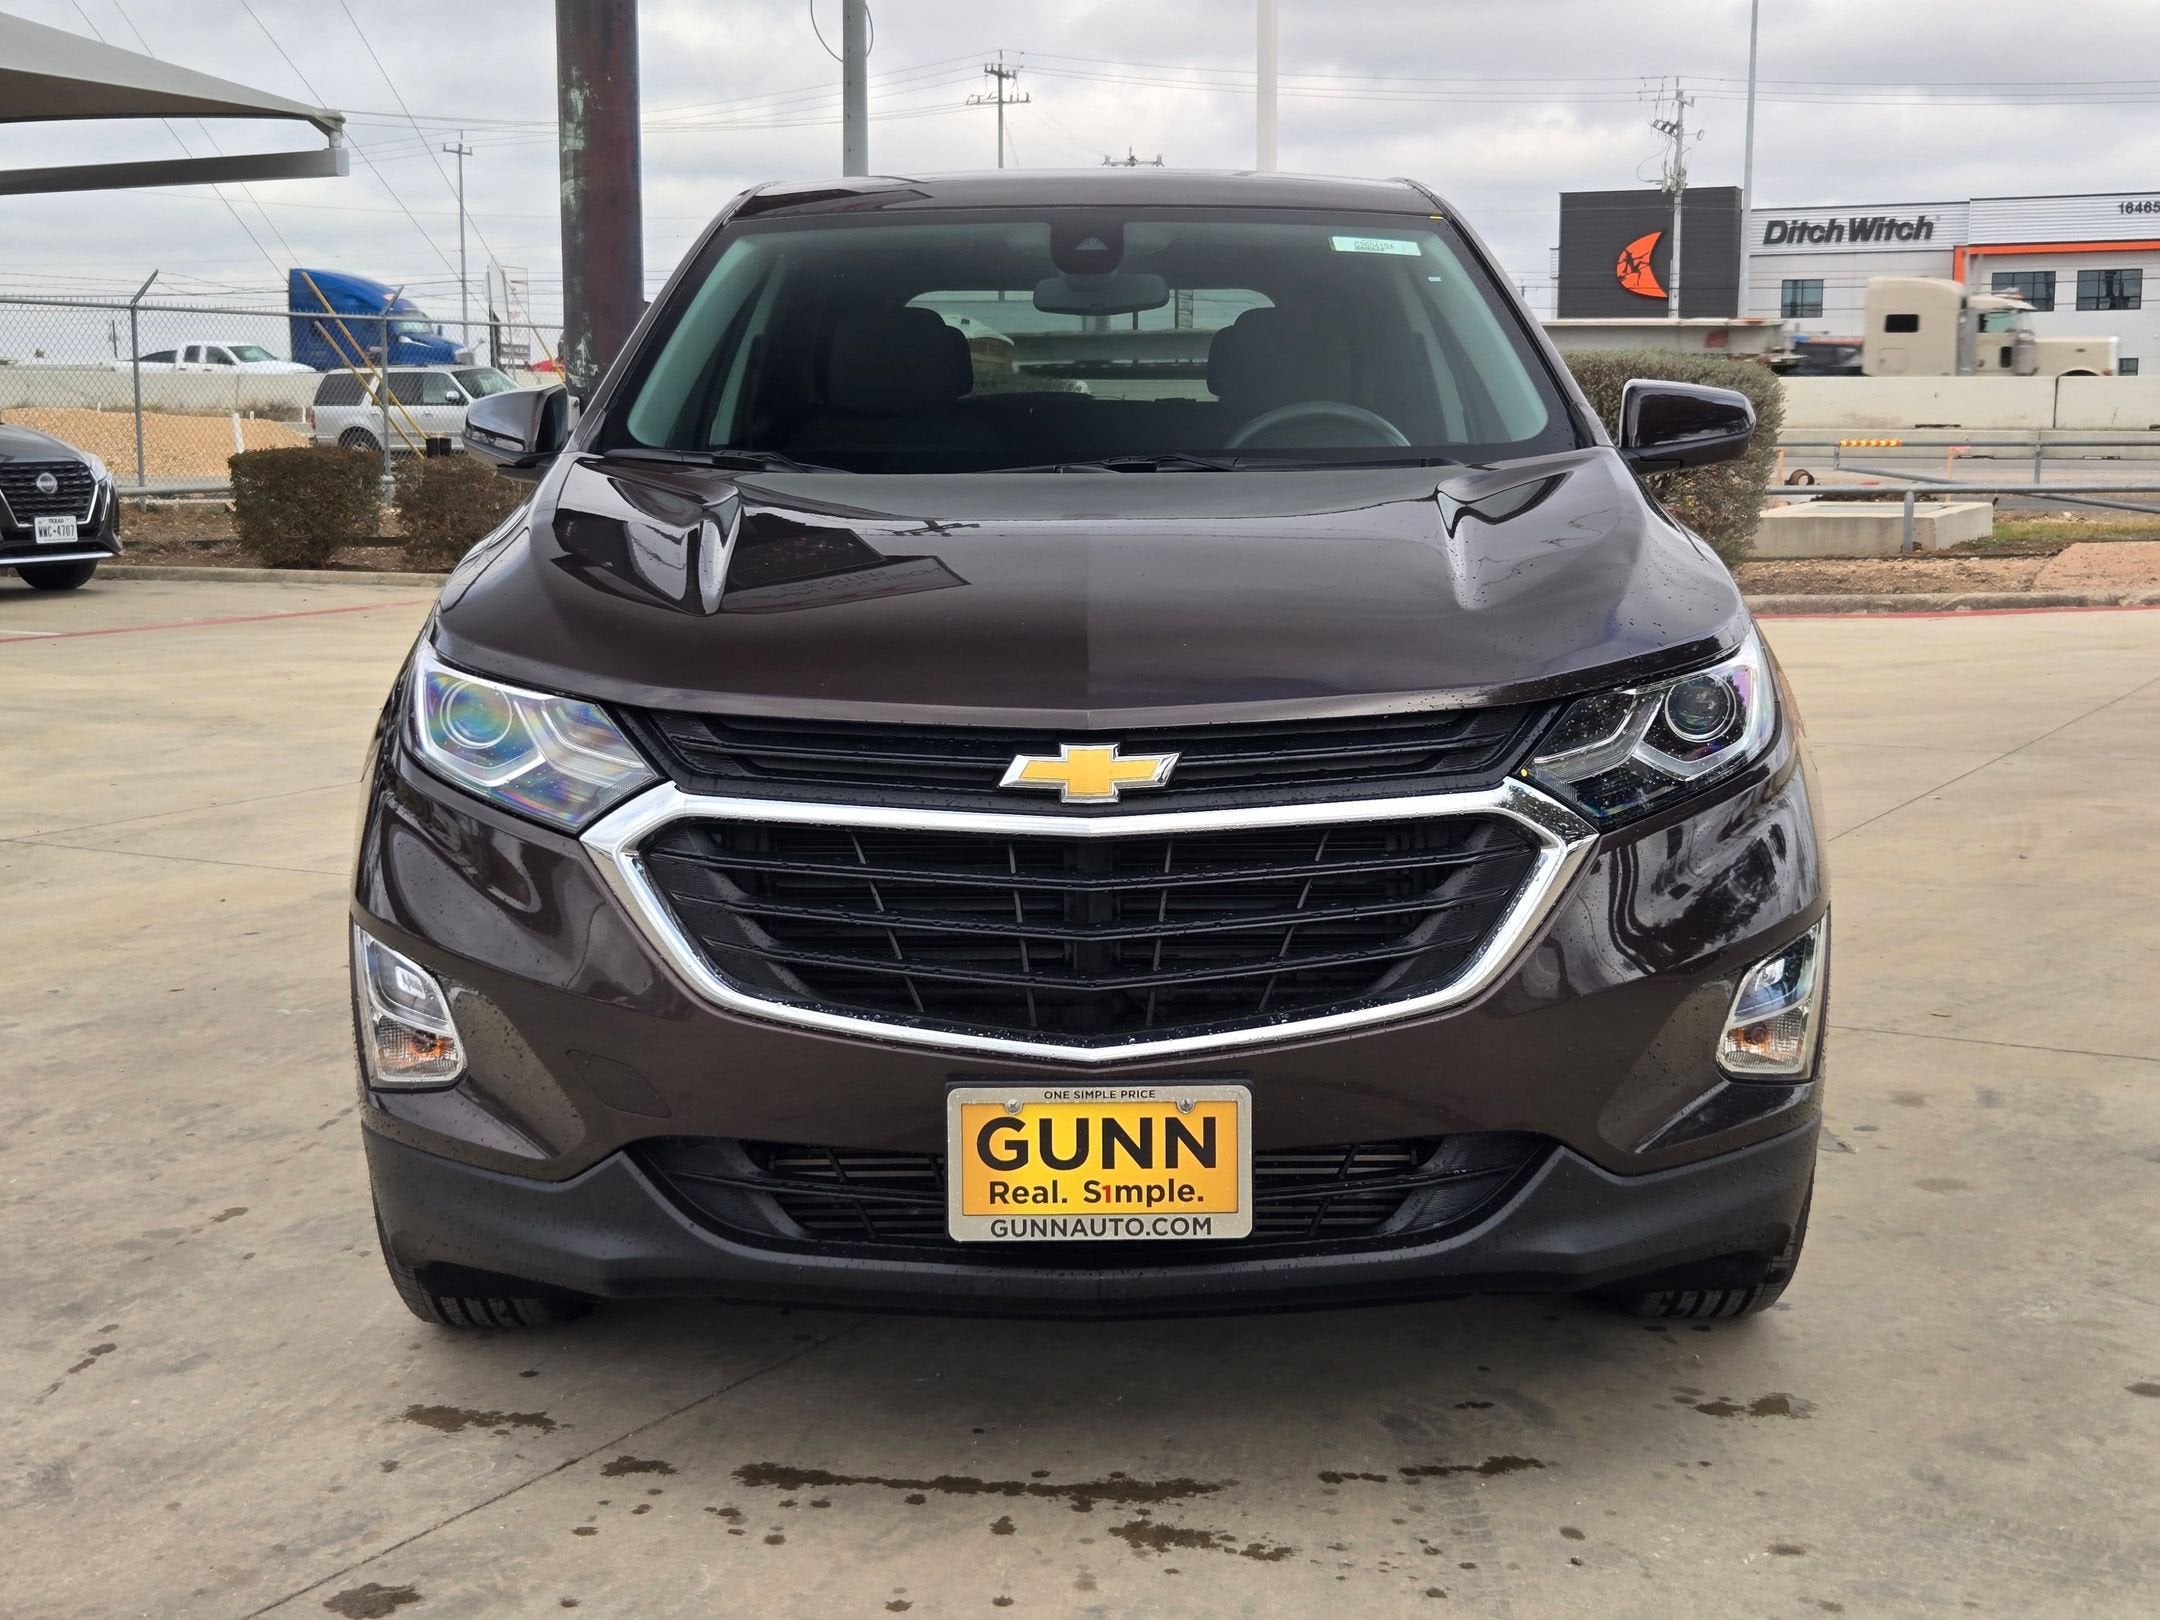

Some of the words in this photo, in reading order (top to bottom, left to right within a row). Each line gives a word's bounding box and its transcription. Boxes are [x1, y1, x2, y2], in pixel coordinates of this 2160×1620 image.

[2118, 201, 2160, 215] 16465
[1763, 218, 1845, 245] Ditch
[1848, 215, 1934, 242] Witch
[1044, 1090, 1070, 1100] ONE
[1073, 1090, 1117, 1100] SIMPLE
[1121, 1089, 1156, 1099] PRICE
[976, 1116, 1217, 1172] GUNN
[989, 1180, 1068, 1205] Real.
[990, 1217, 1212, 1238] GUNNAUTO.COM
